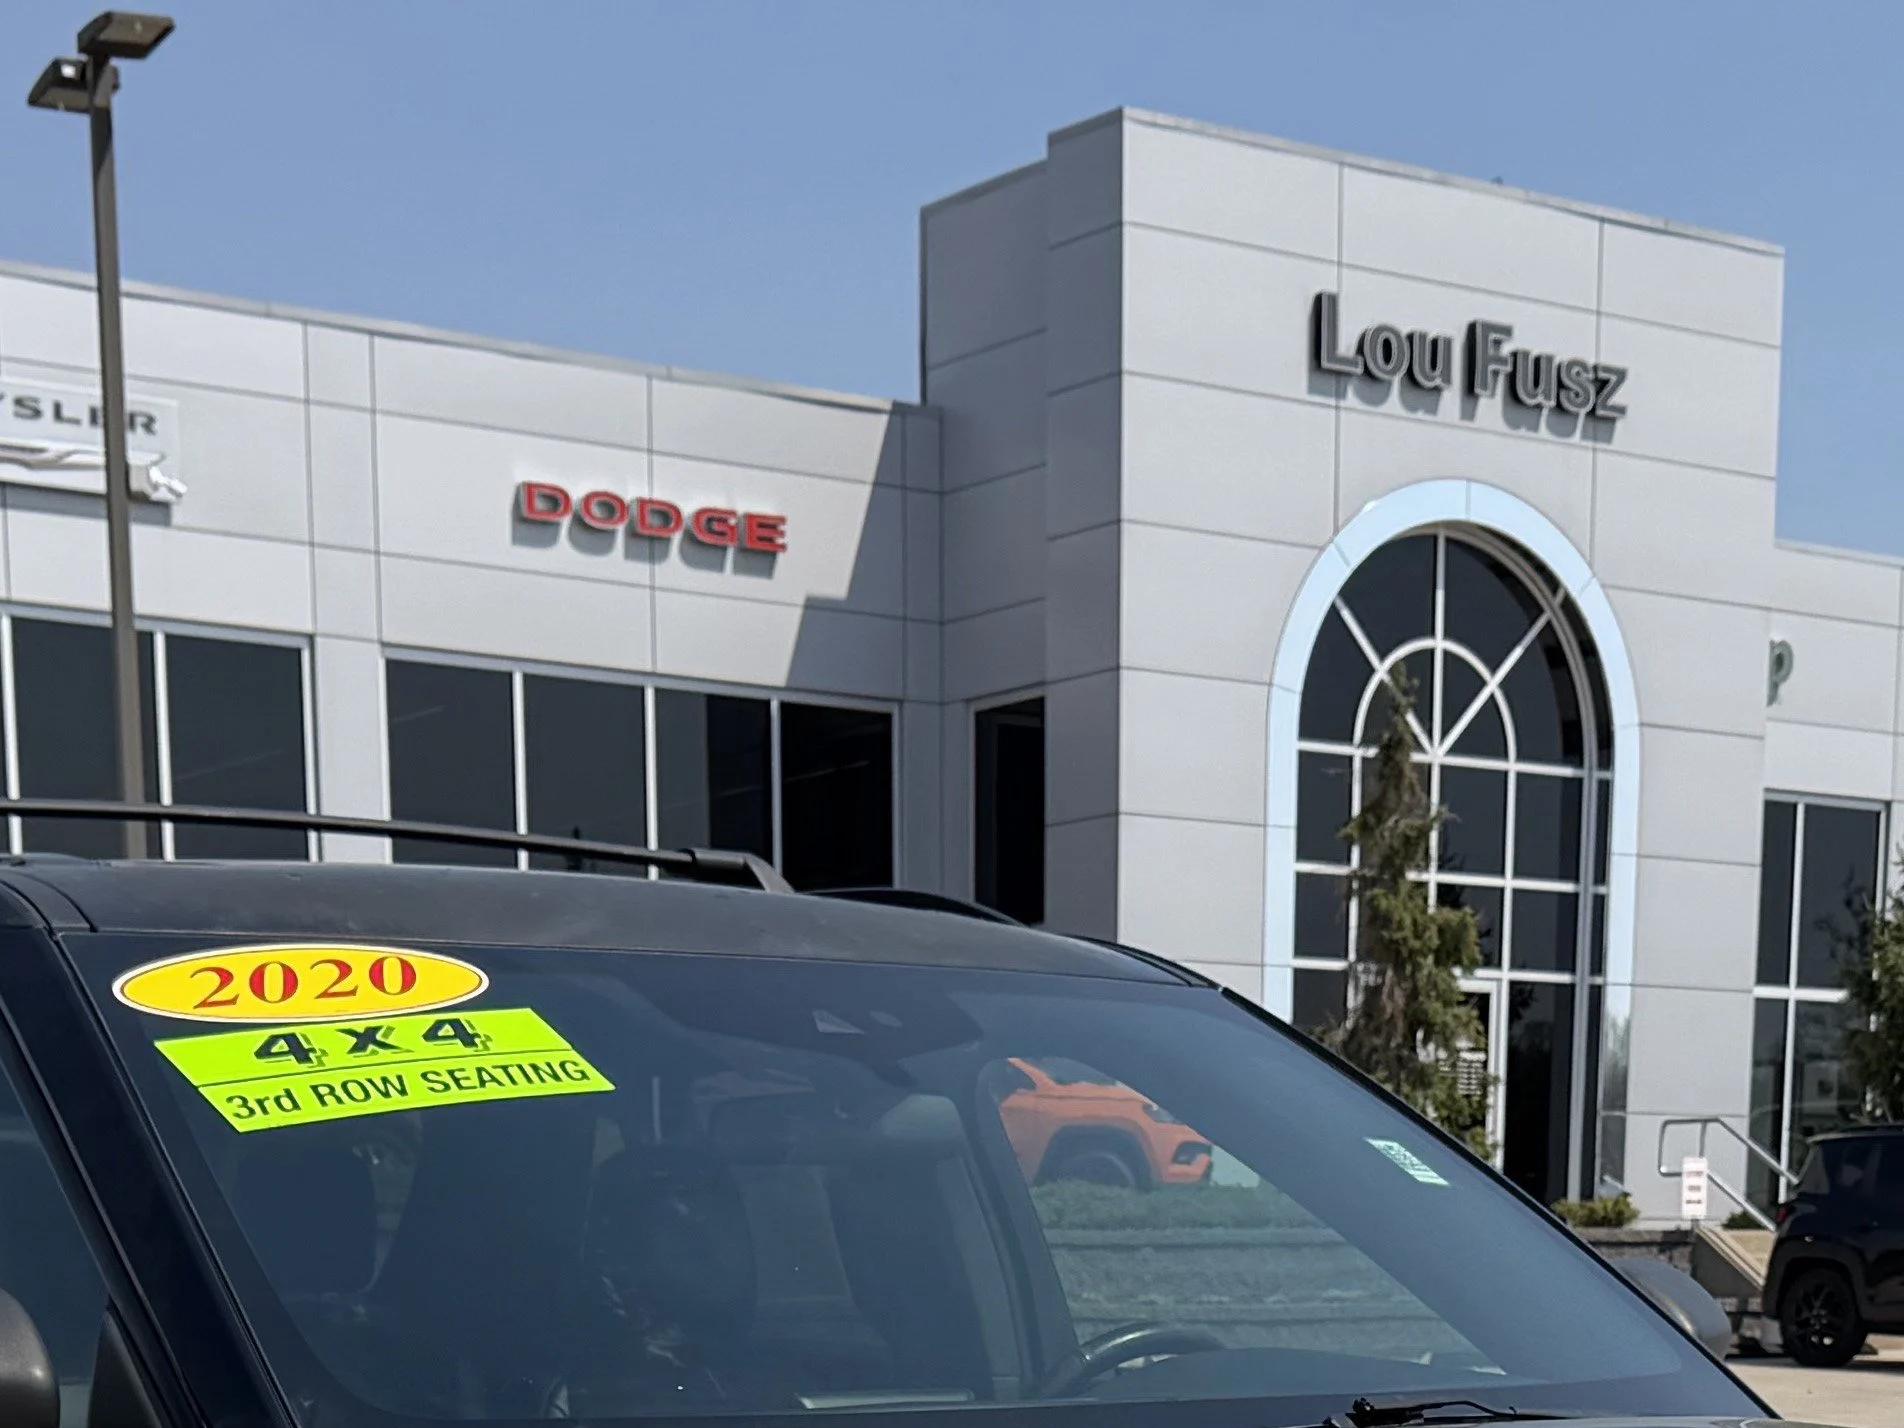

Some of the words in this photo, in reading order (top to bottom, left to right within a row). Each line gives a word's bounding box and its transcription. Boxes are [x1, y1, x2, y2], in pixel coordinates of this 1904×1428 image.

[1309, 290, 1453, 389] Lou
[1462, 318, 1630, 419] Fusz
[513, 481, 788, 553] DODGE
[189, 955, 417, 1010] 2020
[225, 1088, 301, 1121] 3rd
[310, 1074, 410, 1109] ROW
[420, 1058, 591, 1096] SEATING
